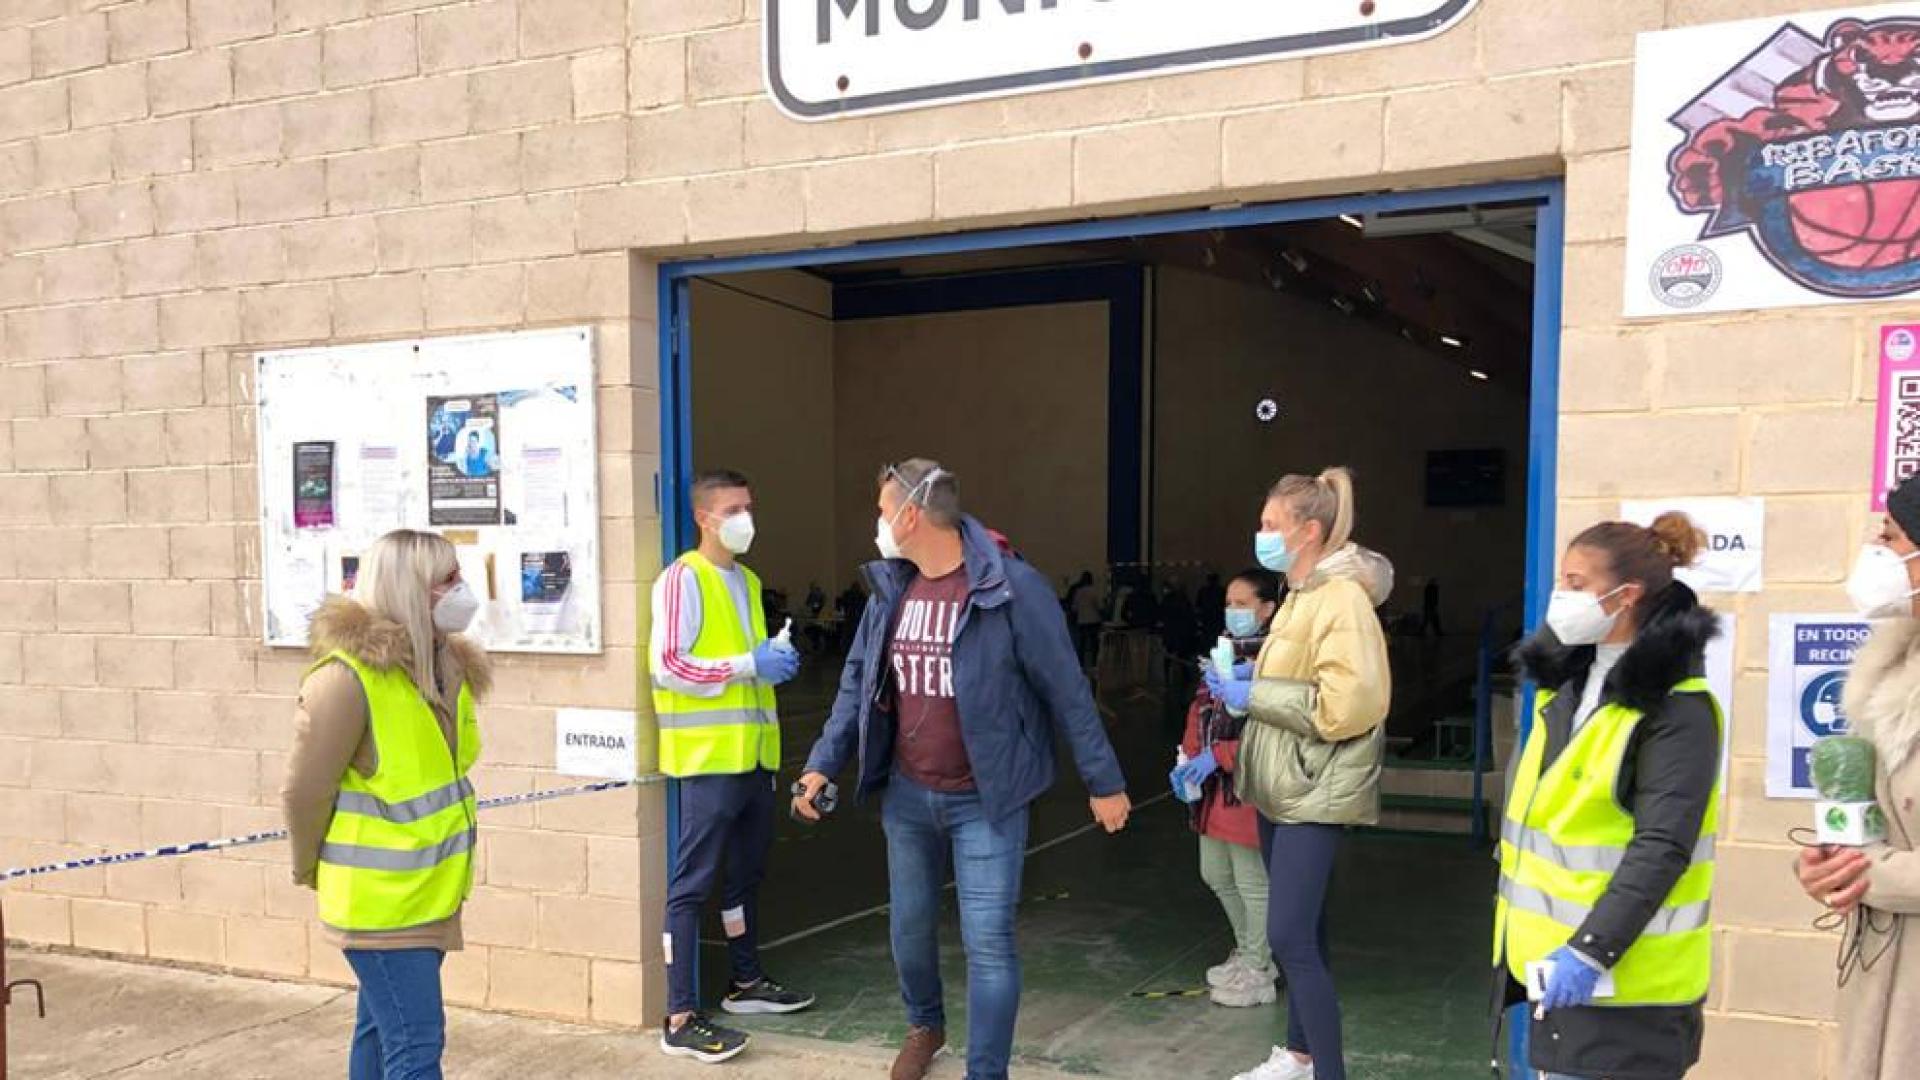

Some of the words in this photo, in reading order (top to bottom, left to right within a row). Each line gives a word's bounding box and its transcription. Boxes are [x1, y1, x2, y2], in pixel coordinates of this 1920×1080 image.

[1797, 628, 1820, 642] EN
[893, 652, 955, 698] STER
[565, 732, 625, 750] ENTRADA
